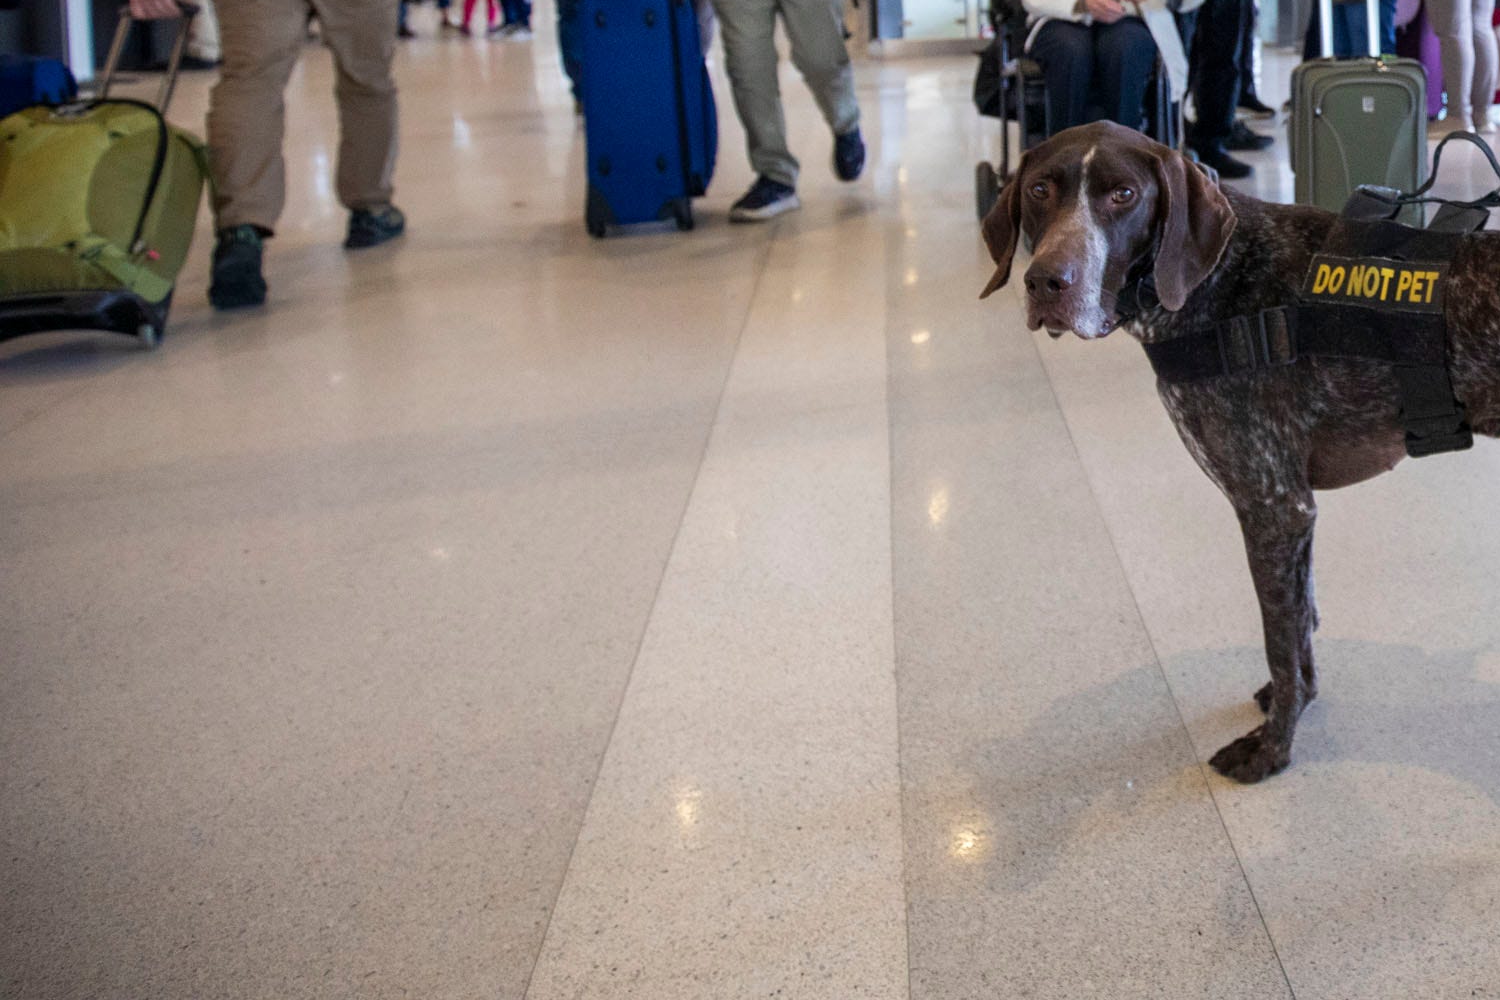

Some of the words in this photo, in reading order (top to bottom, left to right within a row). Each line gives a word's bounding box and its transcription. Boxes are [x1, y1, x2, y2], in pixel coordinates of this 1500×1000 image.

[1312, 264, 1346, 295] DO
[1346, 265, 1395, 301] NOT
[1395, 269, 1440, 304] PET
